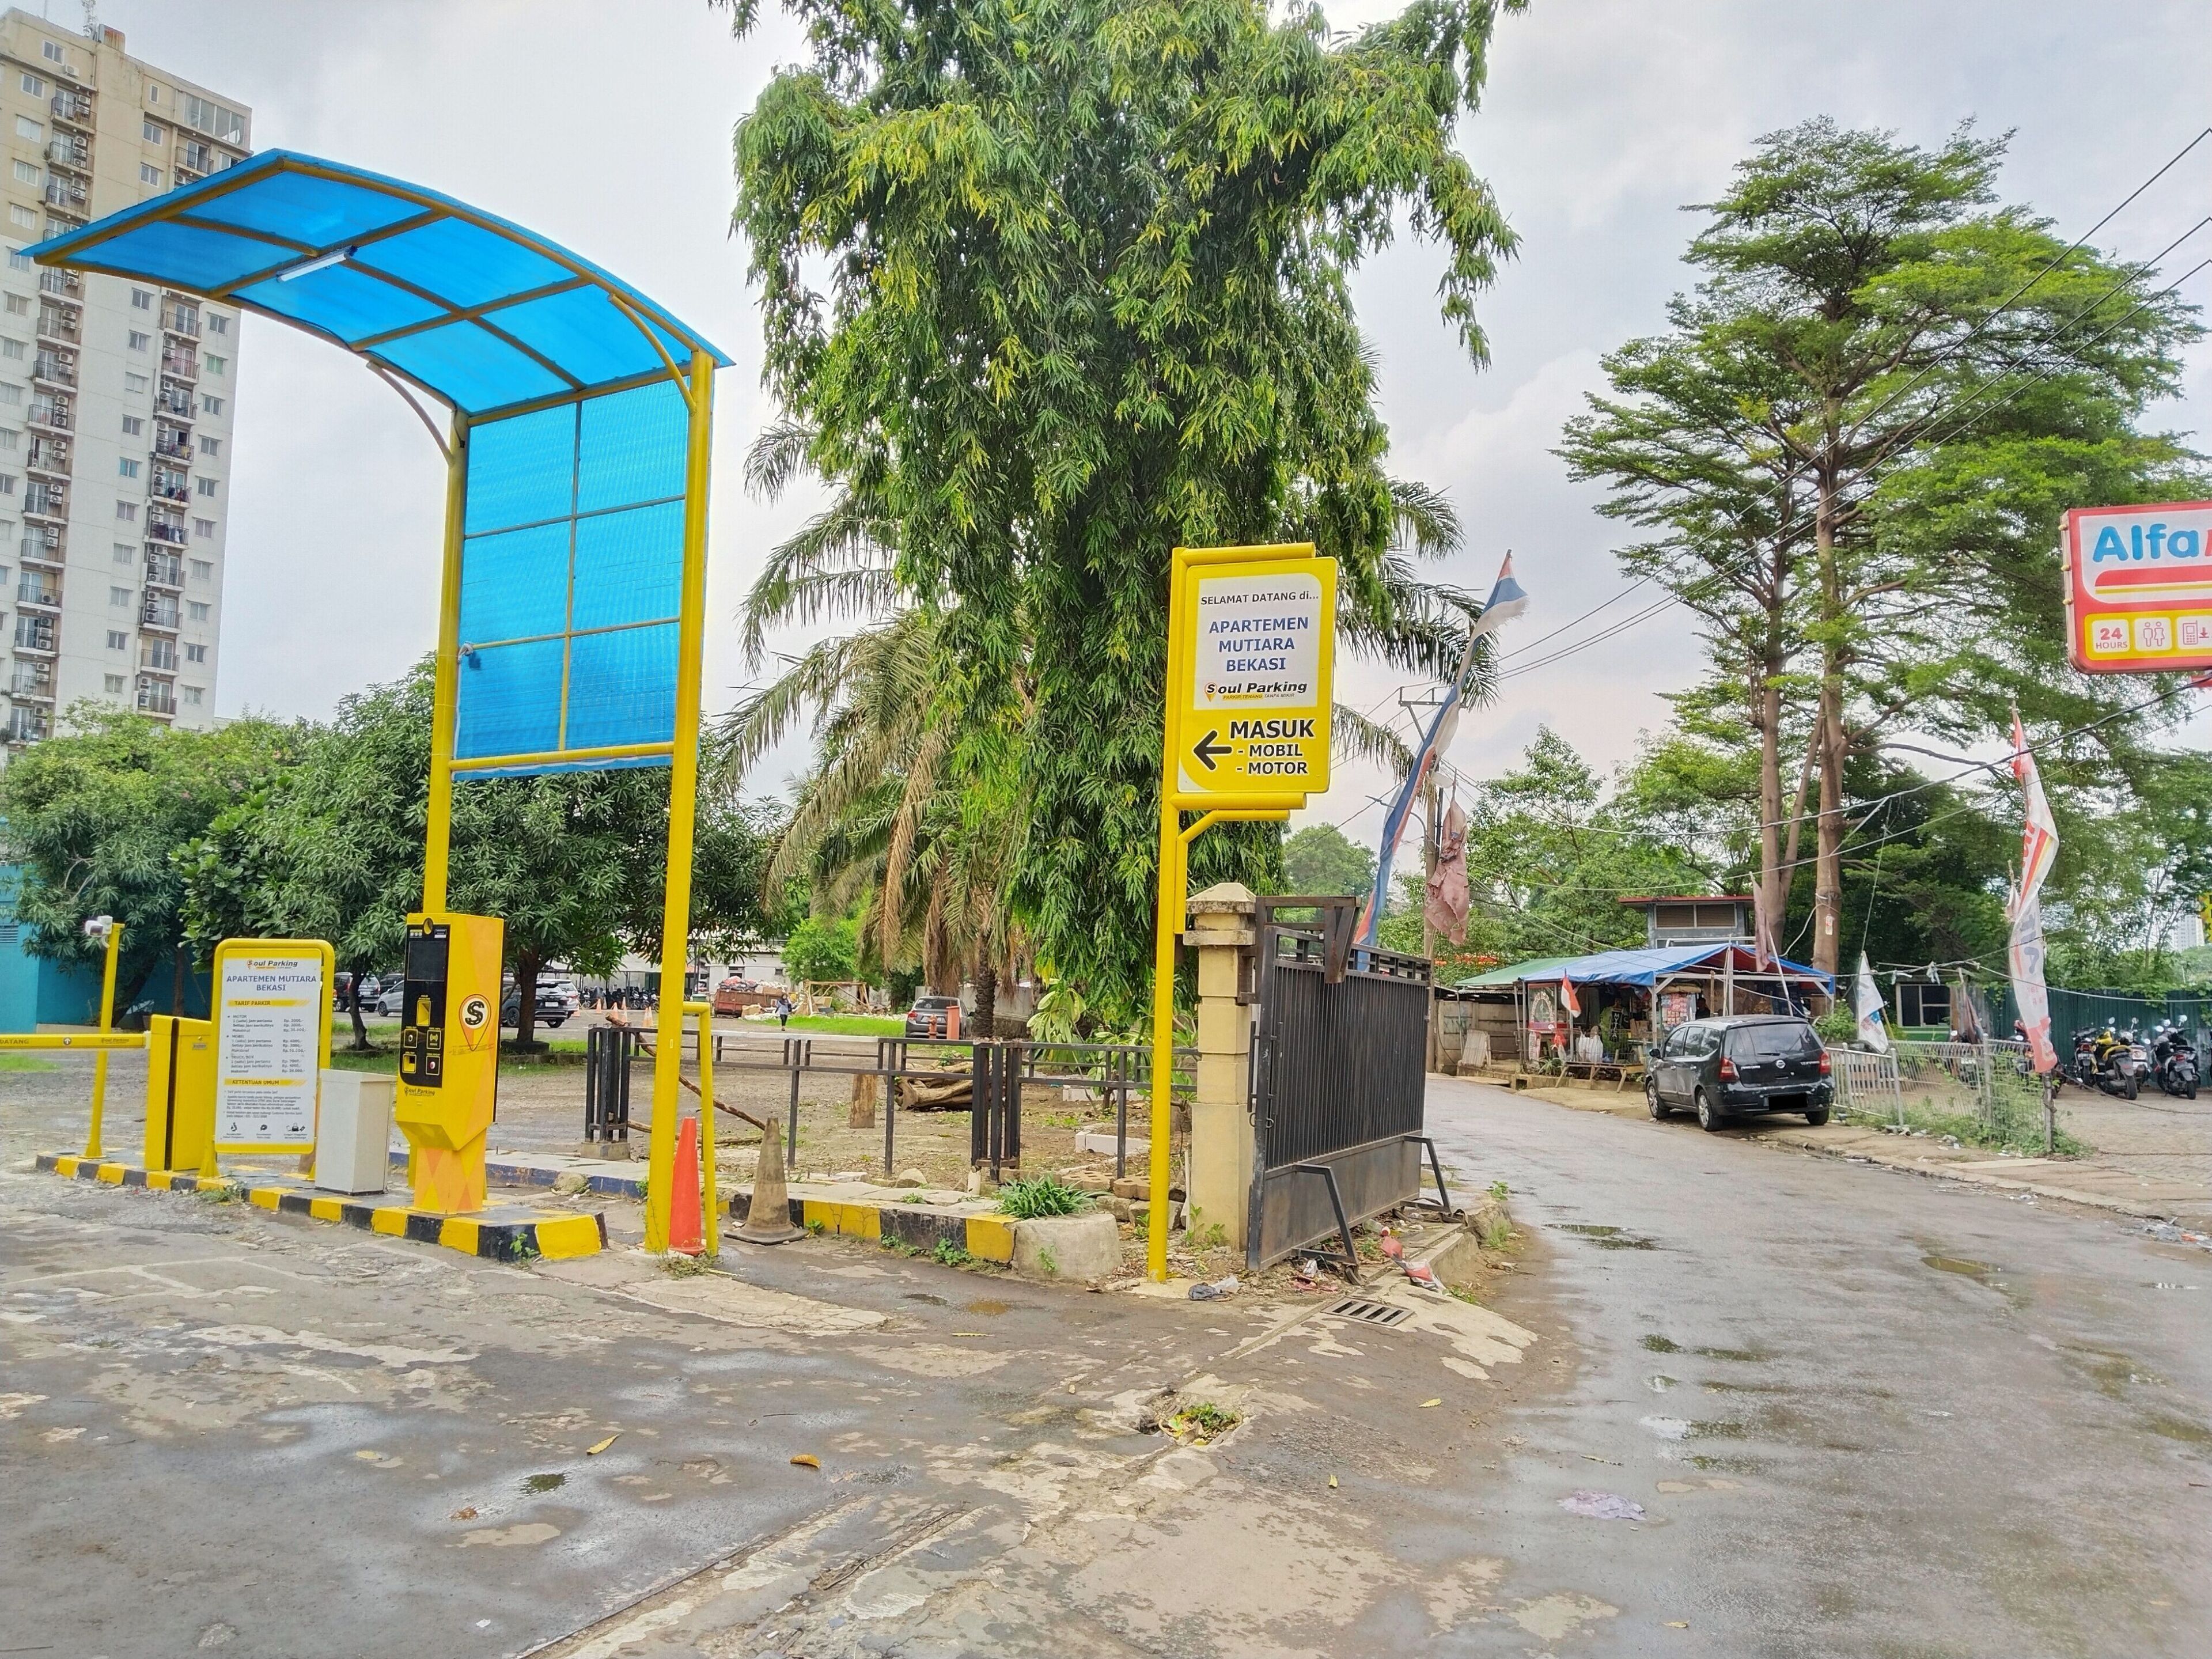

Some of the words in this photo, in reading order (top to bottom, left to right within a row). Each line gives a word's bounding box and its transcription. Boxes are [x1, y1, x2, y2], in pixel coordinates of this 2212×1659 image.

[2093, 524, 2212, 563] Alfa
[1201, 594, 1248, 604] SELAMAT
[1252, 592, 1297, 602] DATANG
[1299, 590, 1319, 600] di...
[1209, 616, 1309, 634] APARTEMEN
[2100, 627, 2123, 640] 24
[1219, 637, 1294, 653] MUTIARA
[2096, 641, 2128, 649] HOURS
[1226, 657, 1286, 672] BEKASI
[1206, 683, 1242, 694] Soul
[1246, 681, 1308, 694] Parking
[1230, 720, 1316, 738] MASUK
[1249, 744, 1302, 757] MOBIL
[1248, 762, 1308, 775] MOTOR
